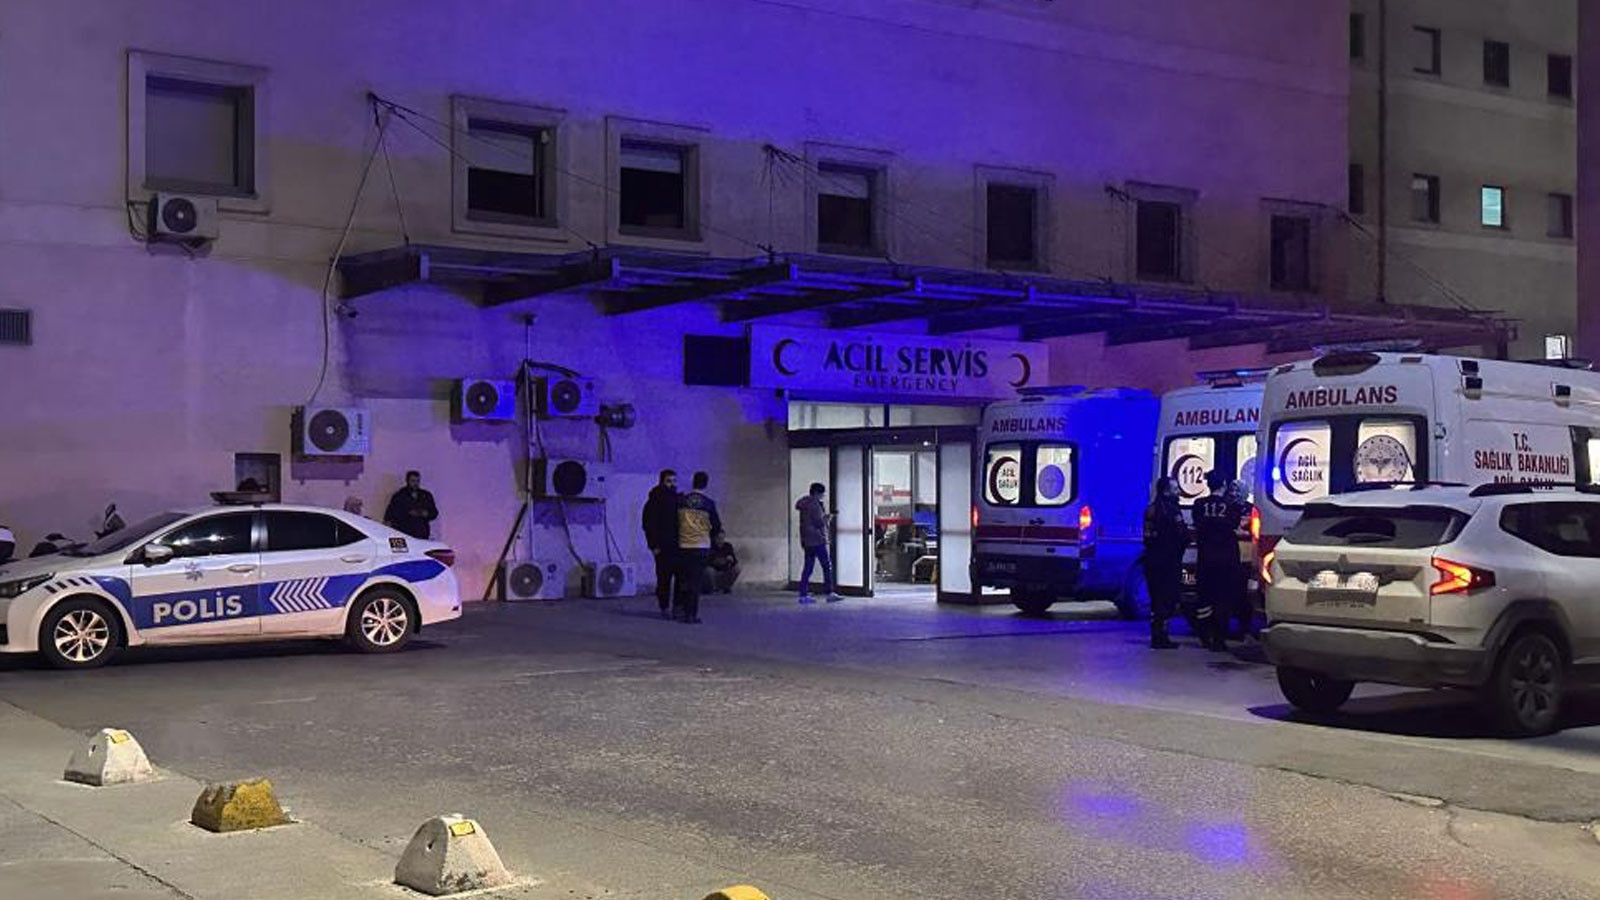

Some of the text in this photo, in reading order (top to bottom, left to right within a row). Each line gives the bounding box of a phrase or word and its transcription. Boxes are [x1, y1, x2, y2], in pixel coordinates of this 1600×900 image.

[823, 336, 987, 378] ACİL SERVİS
[853, 374, 959, 390] EMERGENCY
[1285, 385, 1398, 409] AMBULANS
[992, 416, 1067, 433] AMBULANS
[1513, 433, 1532, 452] T.C.
[1475, 449, 1570, 475] SAĞLIK BAKANLIĞI
[1182, 466, 1203, 484] 112
[1203, 502, 1226, 517] 112
[153, 591, 242, 624] POLİS
